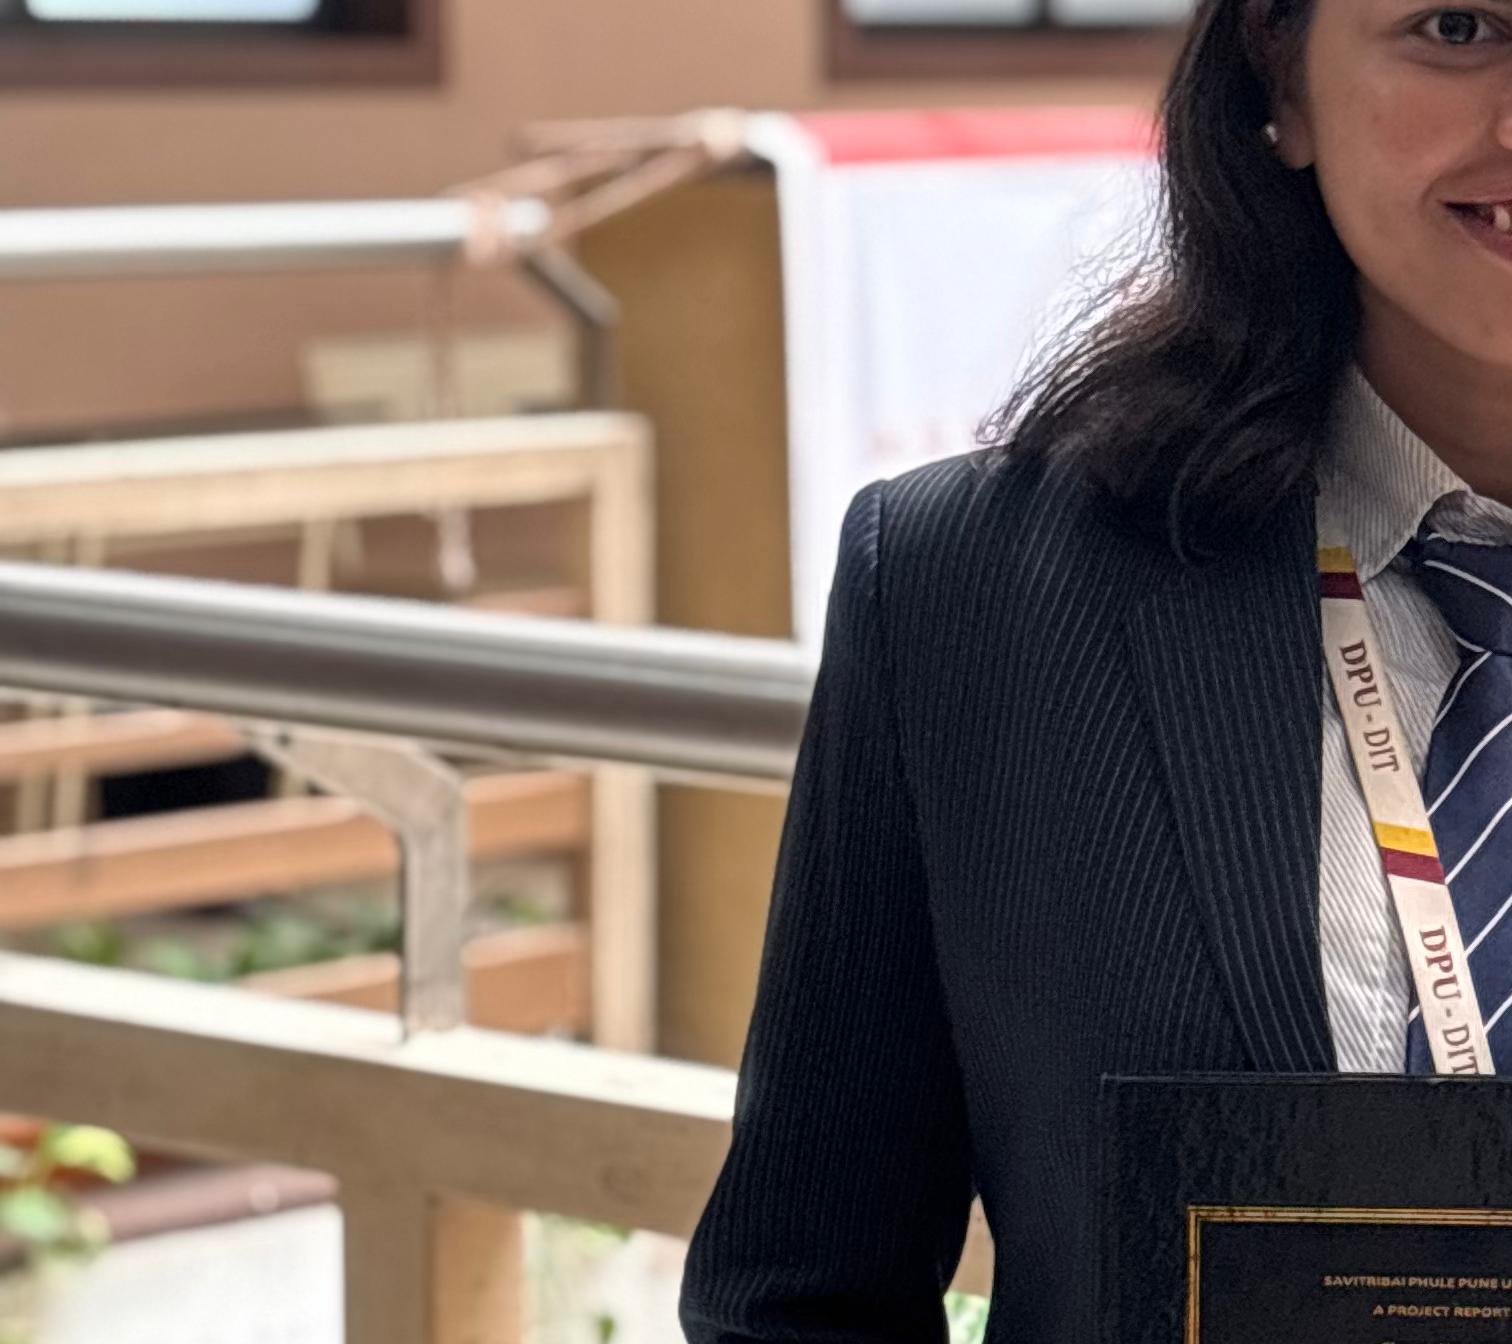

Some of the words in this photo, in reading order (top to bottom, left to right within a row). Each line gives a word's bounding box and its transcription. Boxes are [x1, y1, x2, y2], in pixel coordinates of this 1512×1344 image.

[1340, 639, 1382, 707] DPU
[1363, 727, 1400, 772] DIT
[1419, 925, 1462, 1000] DPU
[1442, 1023, 1480, 1075] DIT
[1324, 1275, 1405, 1289] SAVITRIBAI
[1408, 1277, 1455, 1289] PHULE
[1458, 1277, 1498, 1290] PUNE
[1373, 1305, 1385, 1316] A
[1387, 1305, 1450, 1317] PROJECT
[1454, 1306, 1511, 1318] REPORT
